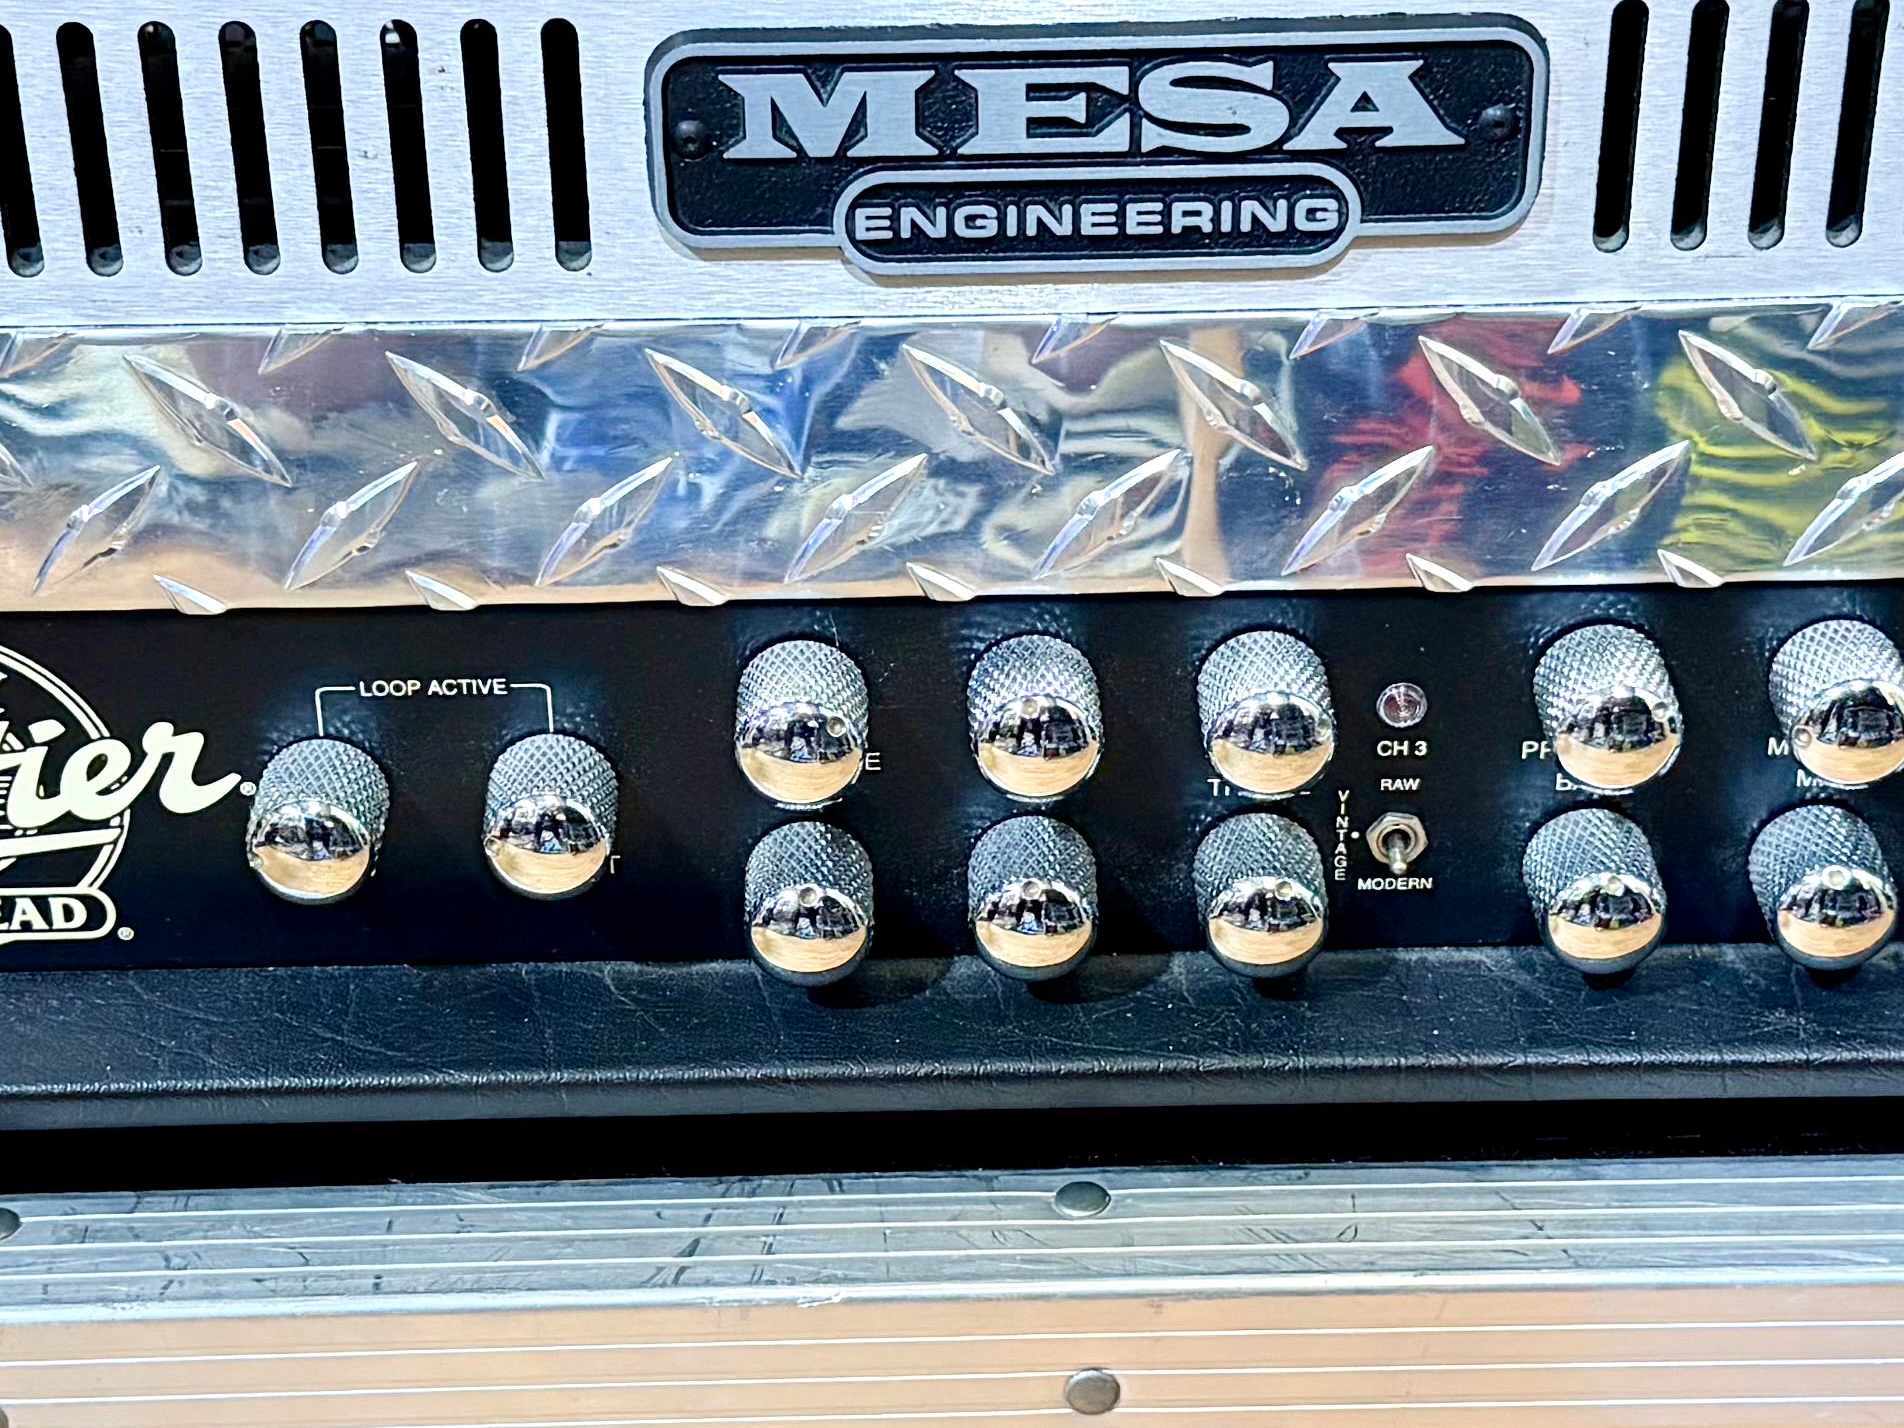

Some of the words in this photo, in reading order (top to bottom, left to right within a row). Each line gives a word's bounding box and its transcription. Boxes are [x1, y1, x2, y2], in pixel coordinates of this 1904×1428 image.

[718, 58, 1466, 161] MESA
[854, 196, 1340, 243] ENGINEERING
[358, 679, 422, 698] LOOP
[427, 677, 509, 696] ACTIVE
[1376, 740, 1410, 757] CH
[1414, 739, 1428, 756] 3
[1379, 777, 1421, 792] RAW
[1333, 789, 1351, 882] VINTAGE
[1356, 876, 1434, 891] MODERN
